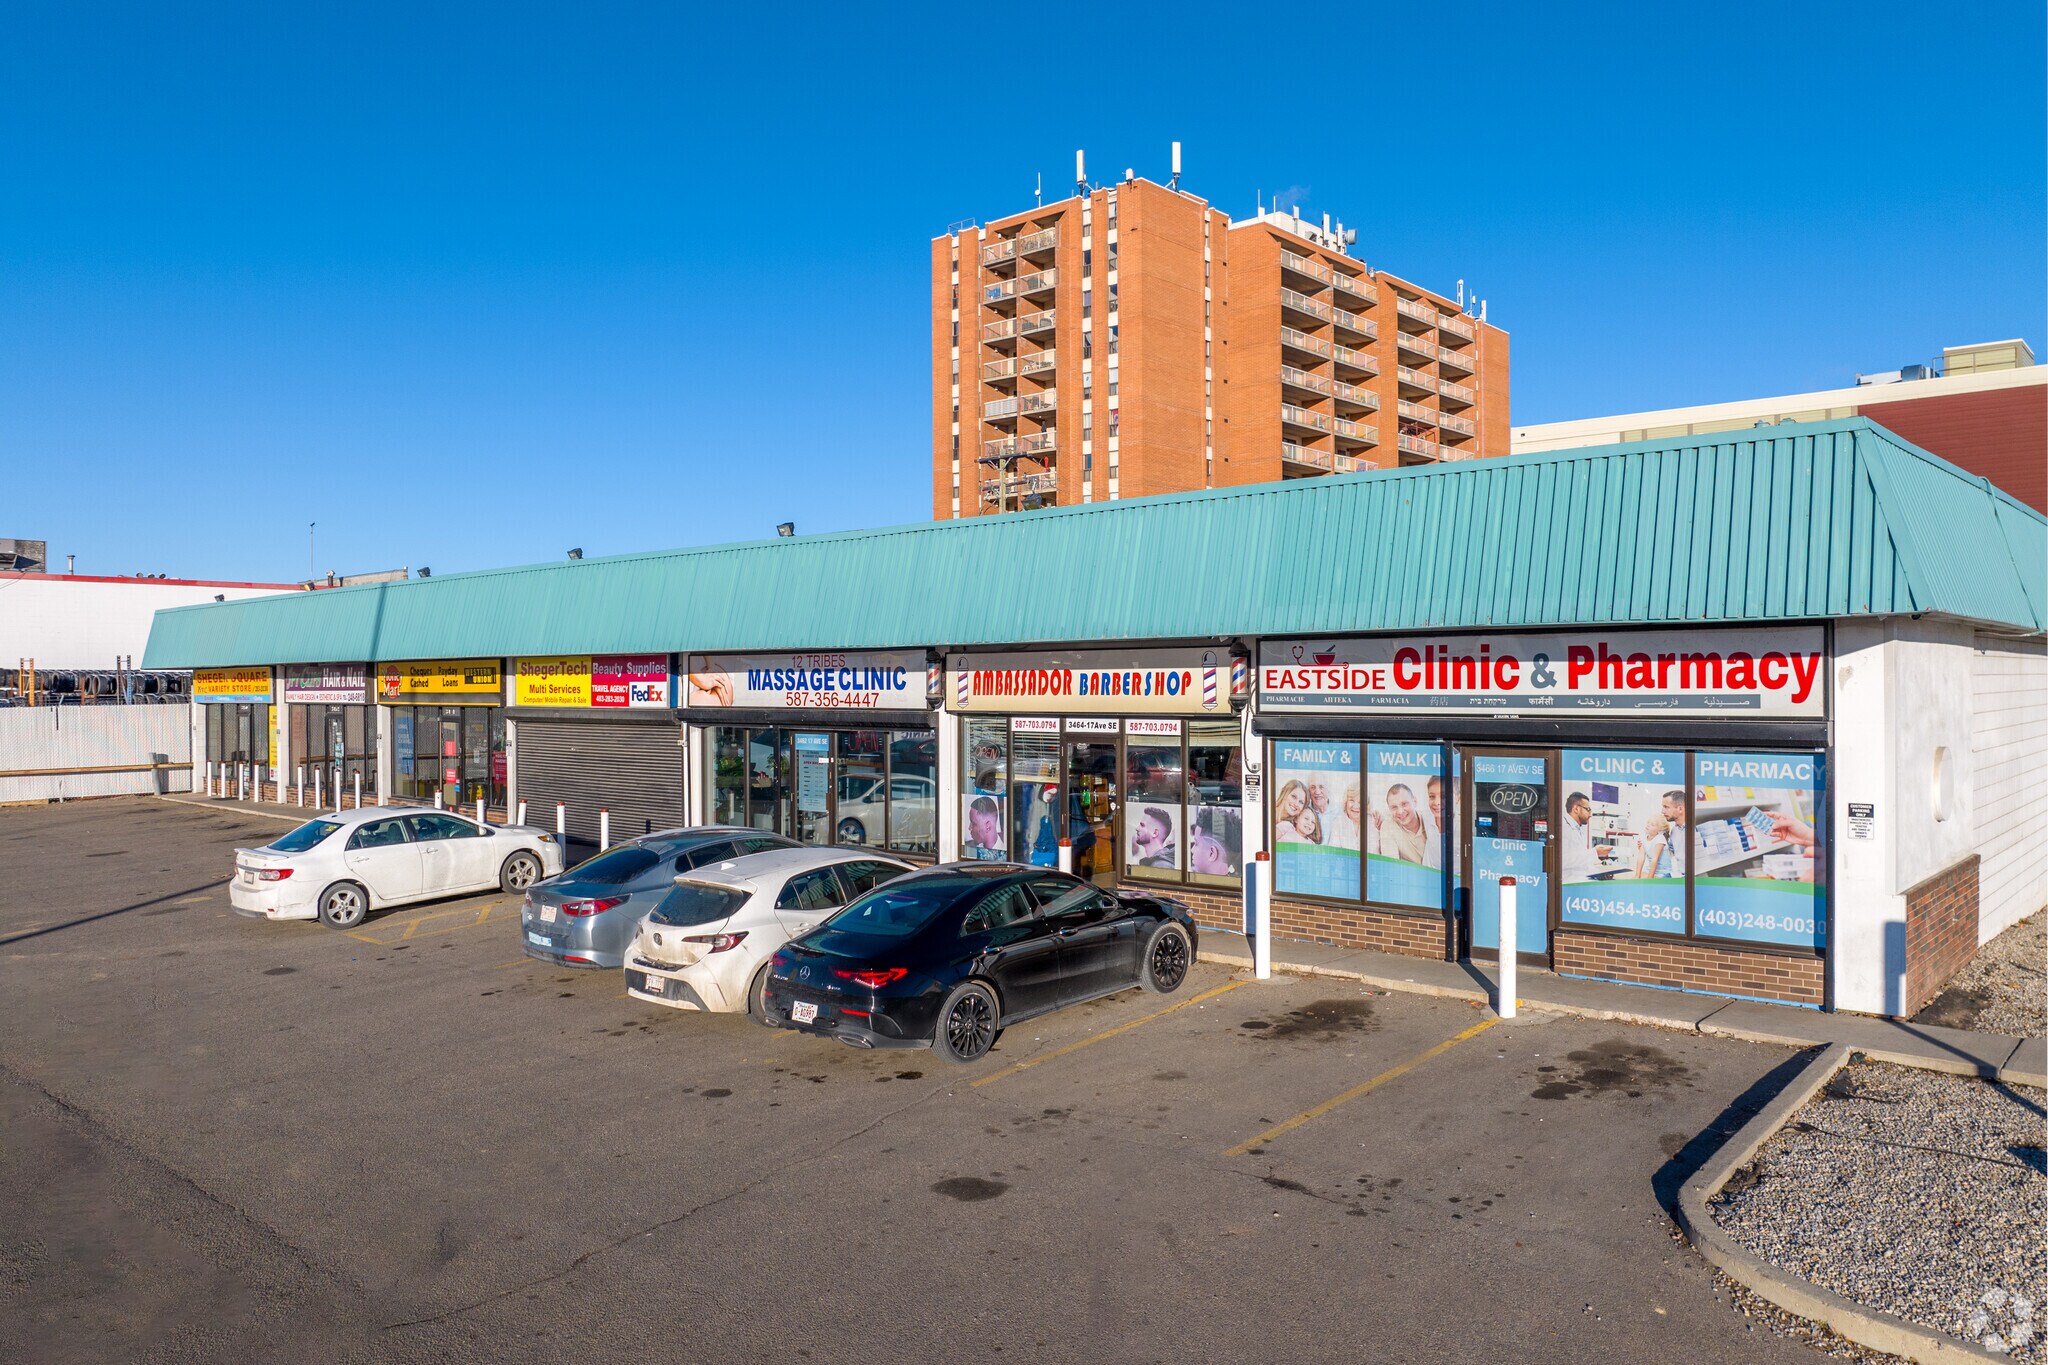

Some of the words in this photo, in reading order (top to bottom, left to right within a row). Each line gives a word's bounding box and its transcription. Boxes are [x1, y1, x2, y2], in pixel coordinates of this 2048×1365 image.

[792, 656, 804, 669] 12
[807, 654, 845, 668] TRIBES
[410, 666, 432, 677] Cheques
[438, 666, 458, 676] Payday
[465, 668, 492, 676] WESTERN
[520, 660, 588, 680] ShegerTech
[592, 662, 623, 678] Beauty
[627, 661, 667, 677] Supplies
[1393, 643, 1520, 691] Clinic
[1530, 652, 1558, 689] &
[1567, 642, 1821, 704] Pharmacy
[322, 667, 341, 688] HAIR
[346, 667, 366, 687] NAIL
[410, 678, 429, 688] Cashed
[442, 678, 458, 687] Loans
[472, 676, 493, 684] UNION
[748, 668, 835, 691] MASSAGE
[839, 667, 907, 691] CLINIC
[973, 668, 1073, 696] AMBASSADOR
[1265, 668, 1386, 690] EASTSIDE
[383, 682, 401, 696] Mart
[529, 684, 547, 694] Multi
[548, 684, 581, 694] Services
[592, 684, 609, 693] TRAVEL
[609, 685, 629, 693] AGENCY
[631, 684, 663, 702] FedEx
[786, 692, 880, 708] 587-356-4447
[1266, 696, 1305, 704] PHARMACIE
[1371, 697, 1409, 705] FARMACIA
[1015, 720, 1057, 730] 587-703.0794
[1108, 721, 1117, 730] SE
[1129, 722, 1178, 733] 587-703.0794
[1284, 748, 1336, 764] FAMILY
[1340, 751, 1351, 764] &
[1380, 751, 1432, 768] WALK
[1497, 764, 1506, 773] 17
[1507, 764, 1530, 774] AVEV
[1531, 765, 1543, 775] SE
[1580, 756, 1645, 775] CLINIC
[1651, 759, 1665, 775] &
[1493, 790, 1533, 807] OPEN
[1492, 838, 1527, 851] Clinic
[1504, 855, 1514, 866] &
[1479, 869, 1541, 887] Phaacy
[1565, 896, 1682, 922] (403)454-5346
